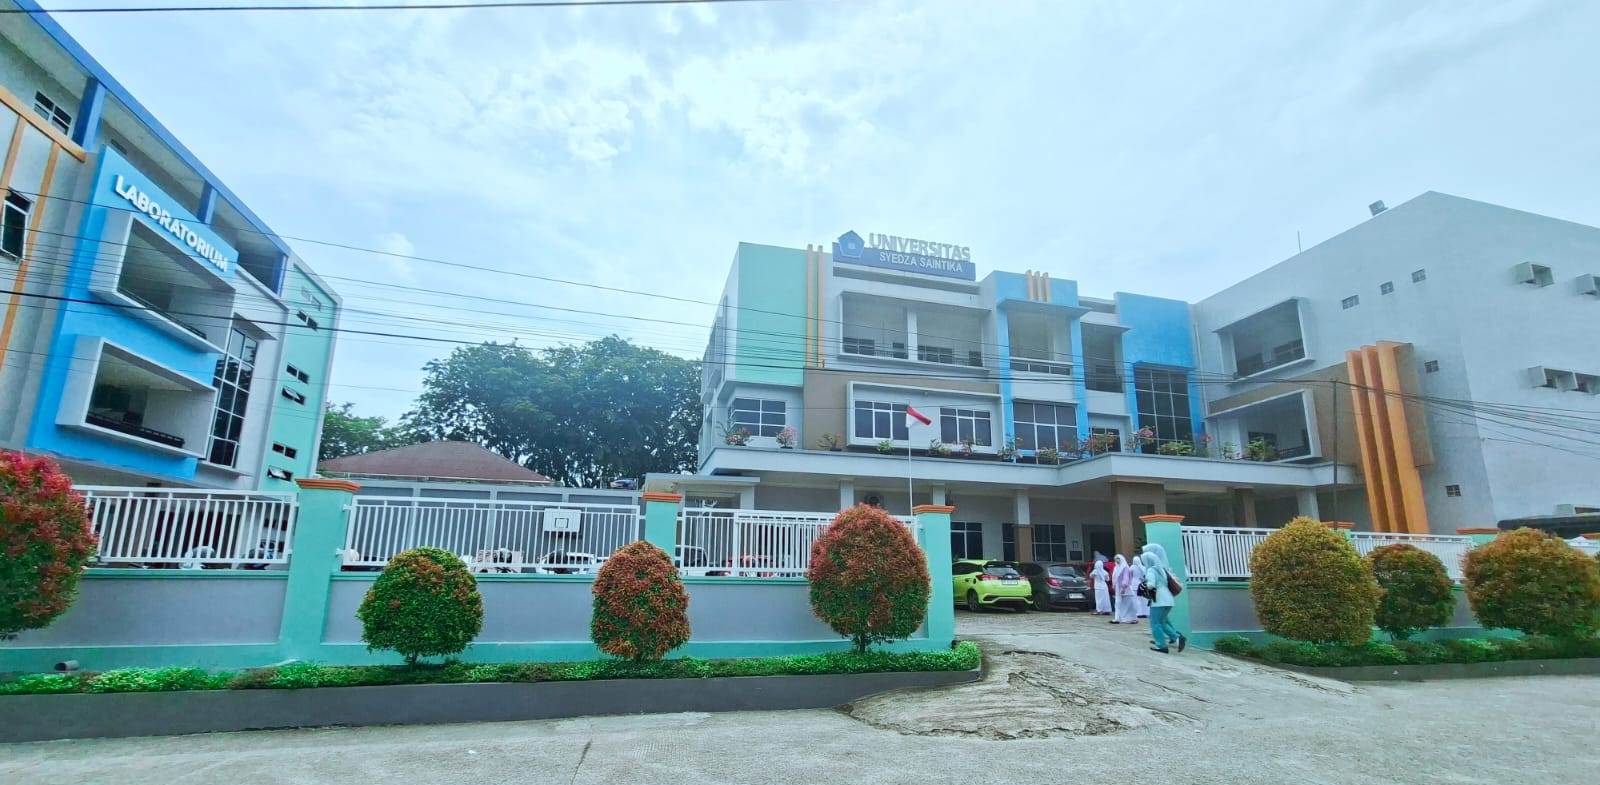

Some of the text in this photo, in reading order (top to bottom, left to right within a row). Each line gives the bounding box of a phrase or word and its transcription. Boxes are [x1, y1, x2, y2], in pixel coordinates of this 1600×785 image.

[115, 174, 228, 272] LABORATORIUM
[870, 233, 971, 260] UNIVERSITAS
[879, 251, 963, 273] SYEDZA SAINTIKA
